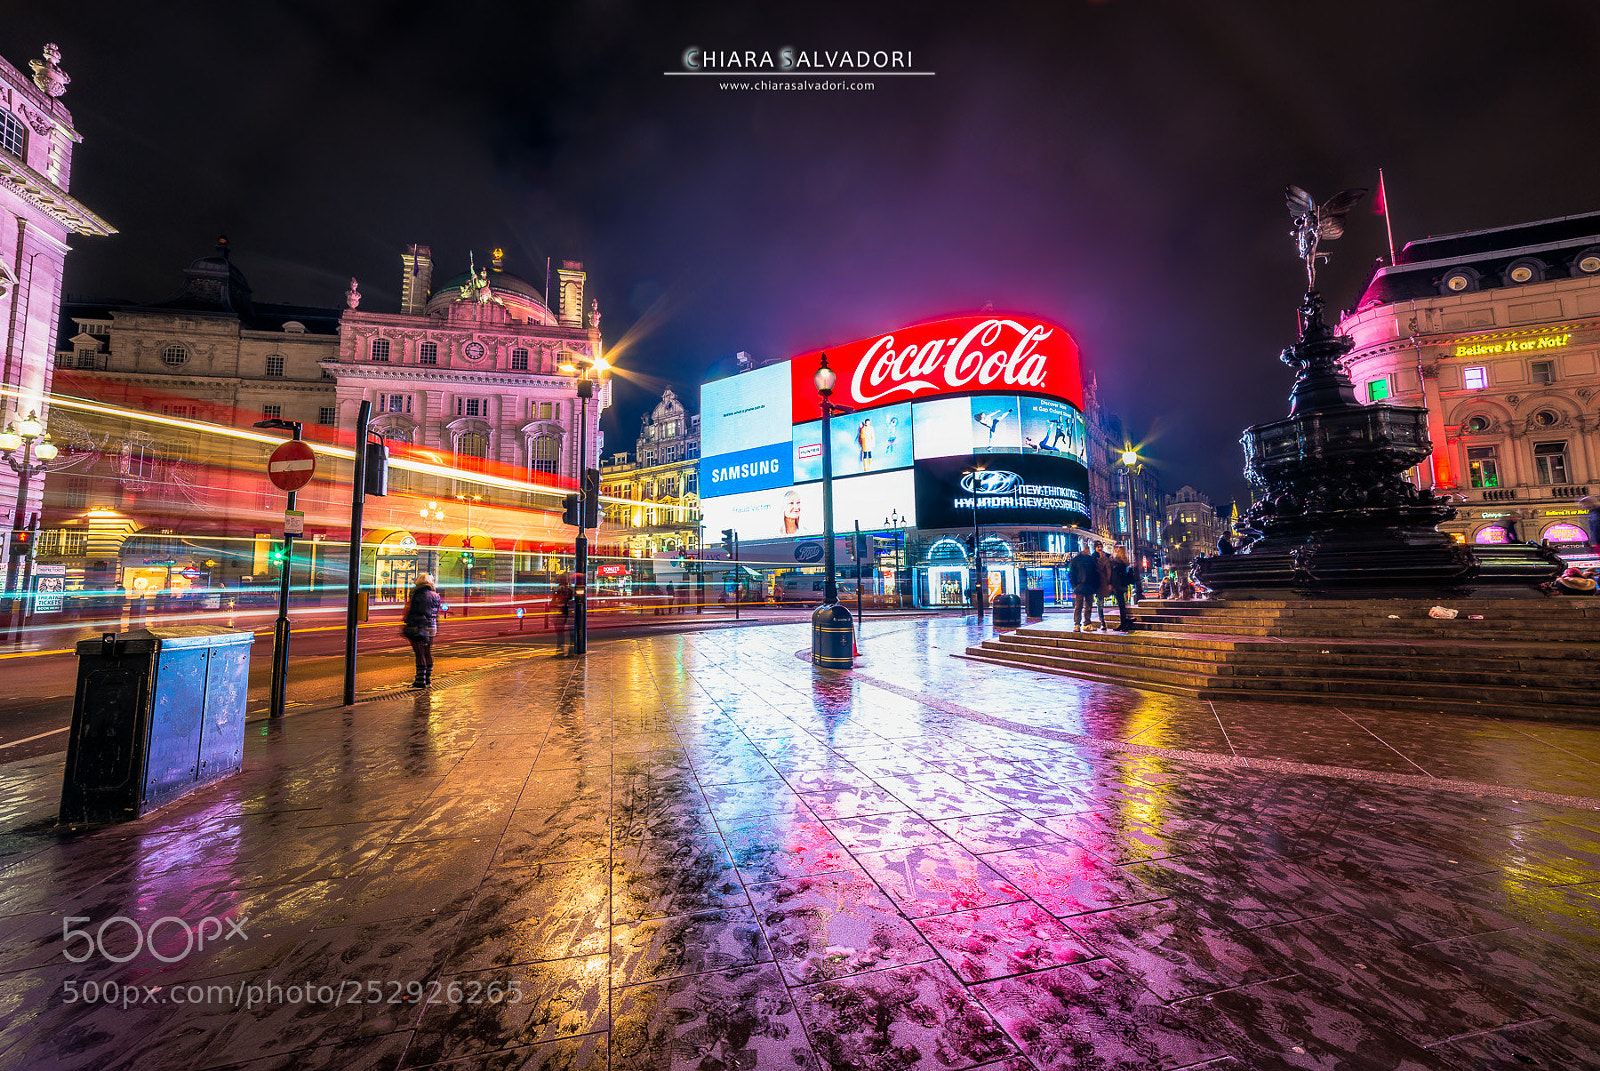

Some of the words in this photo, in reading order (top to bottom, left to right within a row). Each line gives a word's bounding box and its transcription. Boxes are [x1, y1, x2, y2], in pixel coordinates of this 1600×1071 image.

[1455, 342, 1502, 357] Believe
[1504, 340, 1518, 352] It
[1519, 341, 1534, 350] or
[1536, 333, 1569, 350] Not!
[851, 319, 1054, 403] Coca-Cola
[711, 458, 779, 483] SAMSUNG
[954, 496, 1014, 508] HYUNDAI
